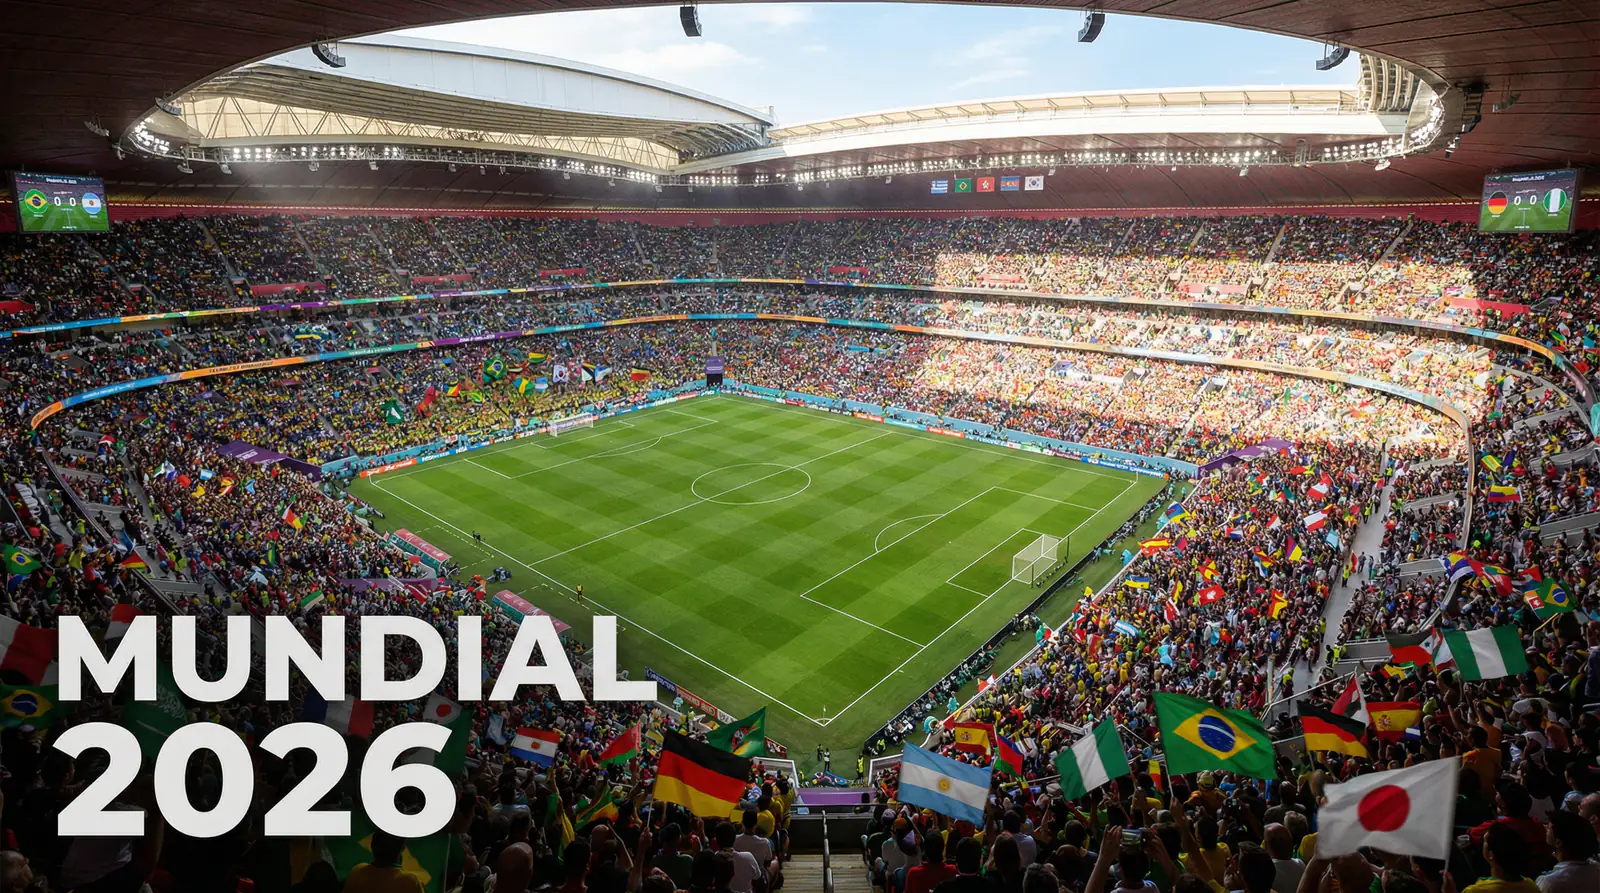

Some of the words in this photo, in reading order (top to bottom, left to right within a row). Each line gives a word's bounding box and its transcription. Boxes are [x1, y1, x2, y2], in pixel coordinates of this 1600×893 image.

[54, 196, 61, 207] 0
[69, 196, 76, 207] 0
[1513, 195, 1521, 206] 0
[1529, 194, 1537, 205] 0
